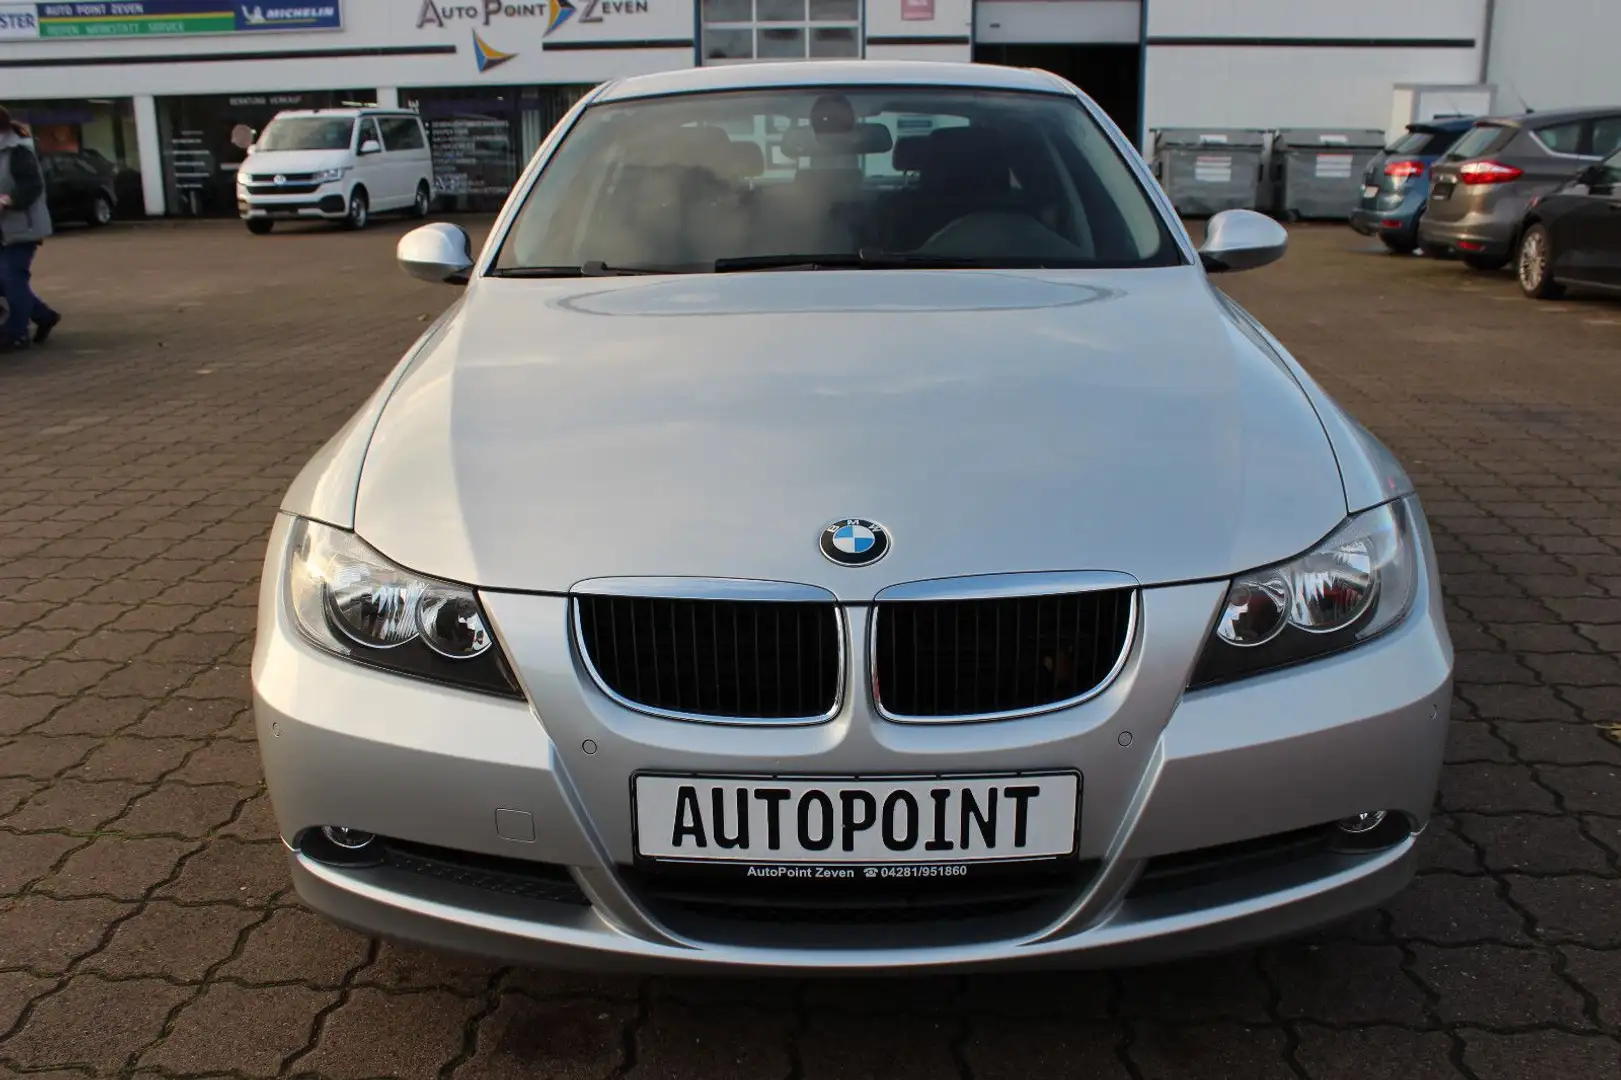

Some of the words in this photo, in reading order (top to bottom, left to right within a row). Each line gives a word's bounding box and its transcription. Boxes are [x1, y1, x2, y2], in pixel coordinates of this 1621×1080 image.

[266, 6, 334, 19] MICHELIN
[672, 786, 1041, 852] AUTOPOINT
[746, 865, 812, 879] AutoPoint
[815, 866, 855, 879] Zeven
[881, 865, 967, 878] 04281/951860
